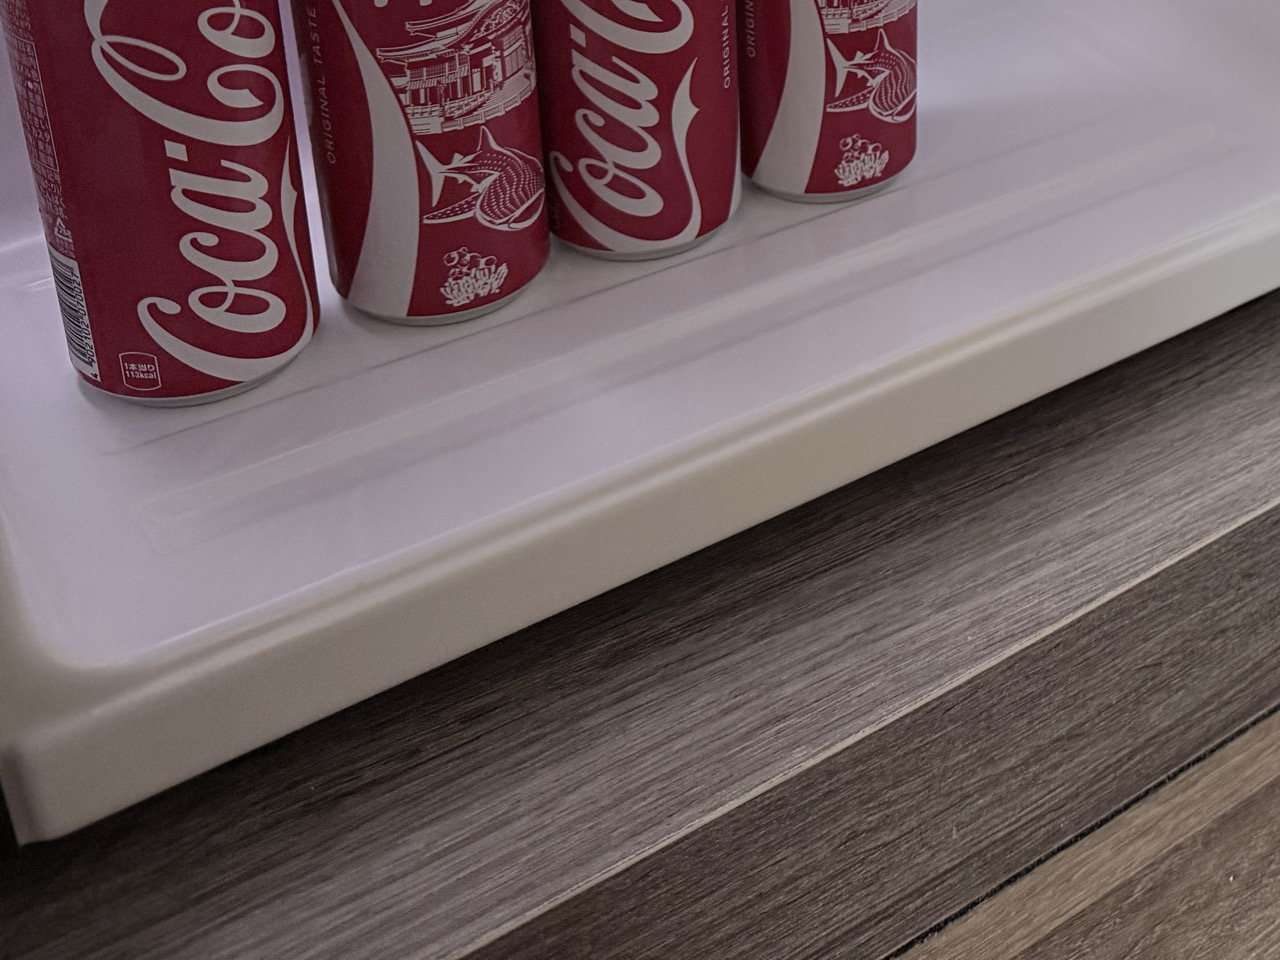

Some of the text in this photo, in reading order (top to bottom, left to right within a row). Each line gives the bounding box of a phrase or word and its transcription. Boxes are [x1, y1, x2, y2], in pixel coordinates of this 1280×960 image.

[307, 6, 337, 164] ORIGINAL TASTE
[722, 5, 731, 89] ORIGINAL
[125, 371, 157, 379] 113kcal
